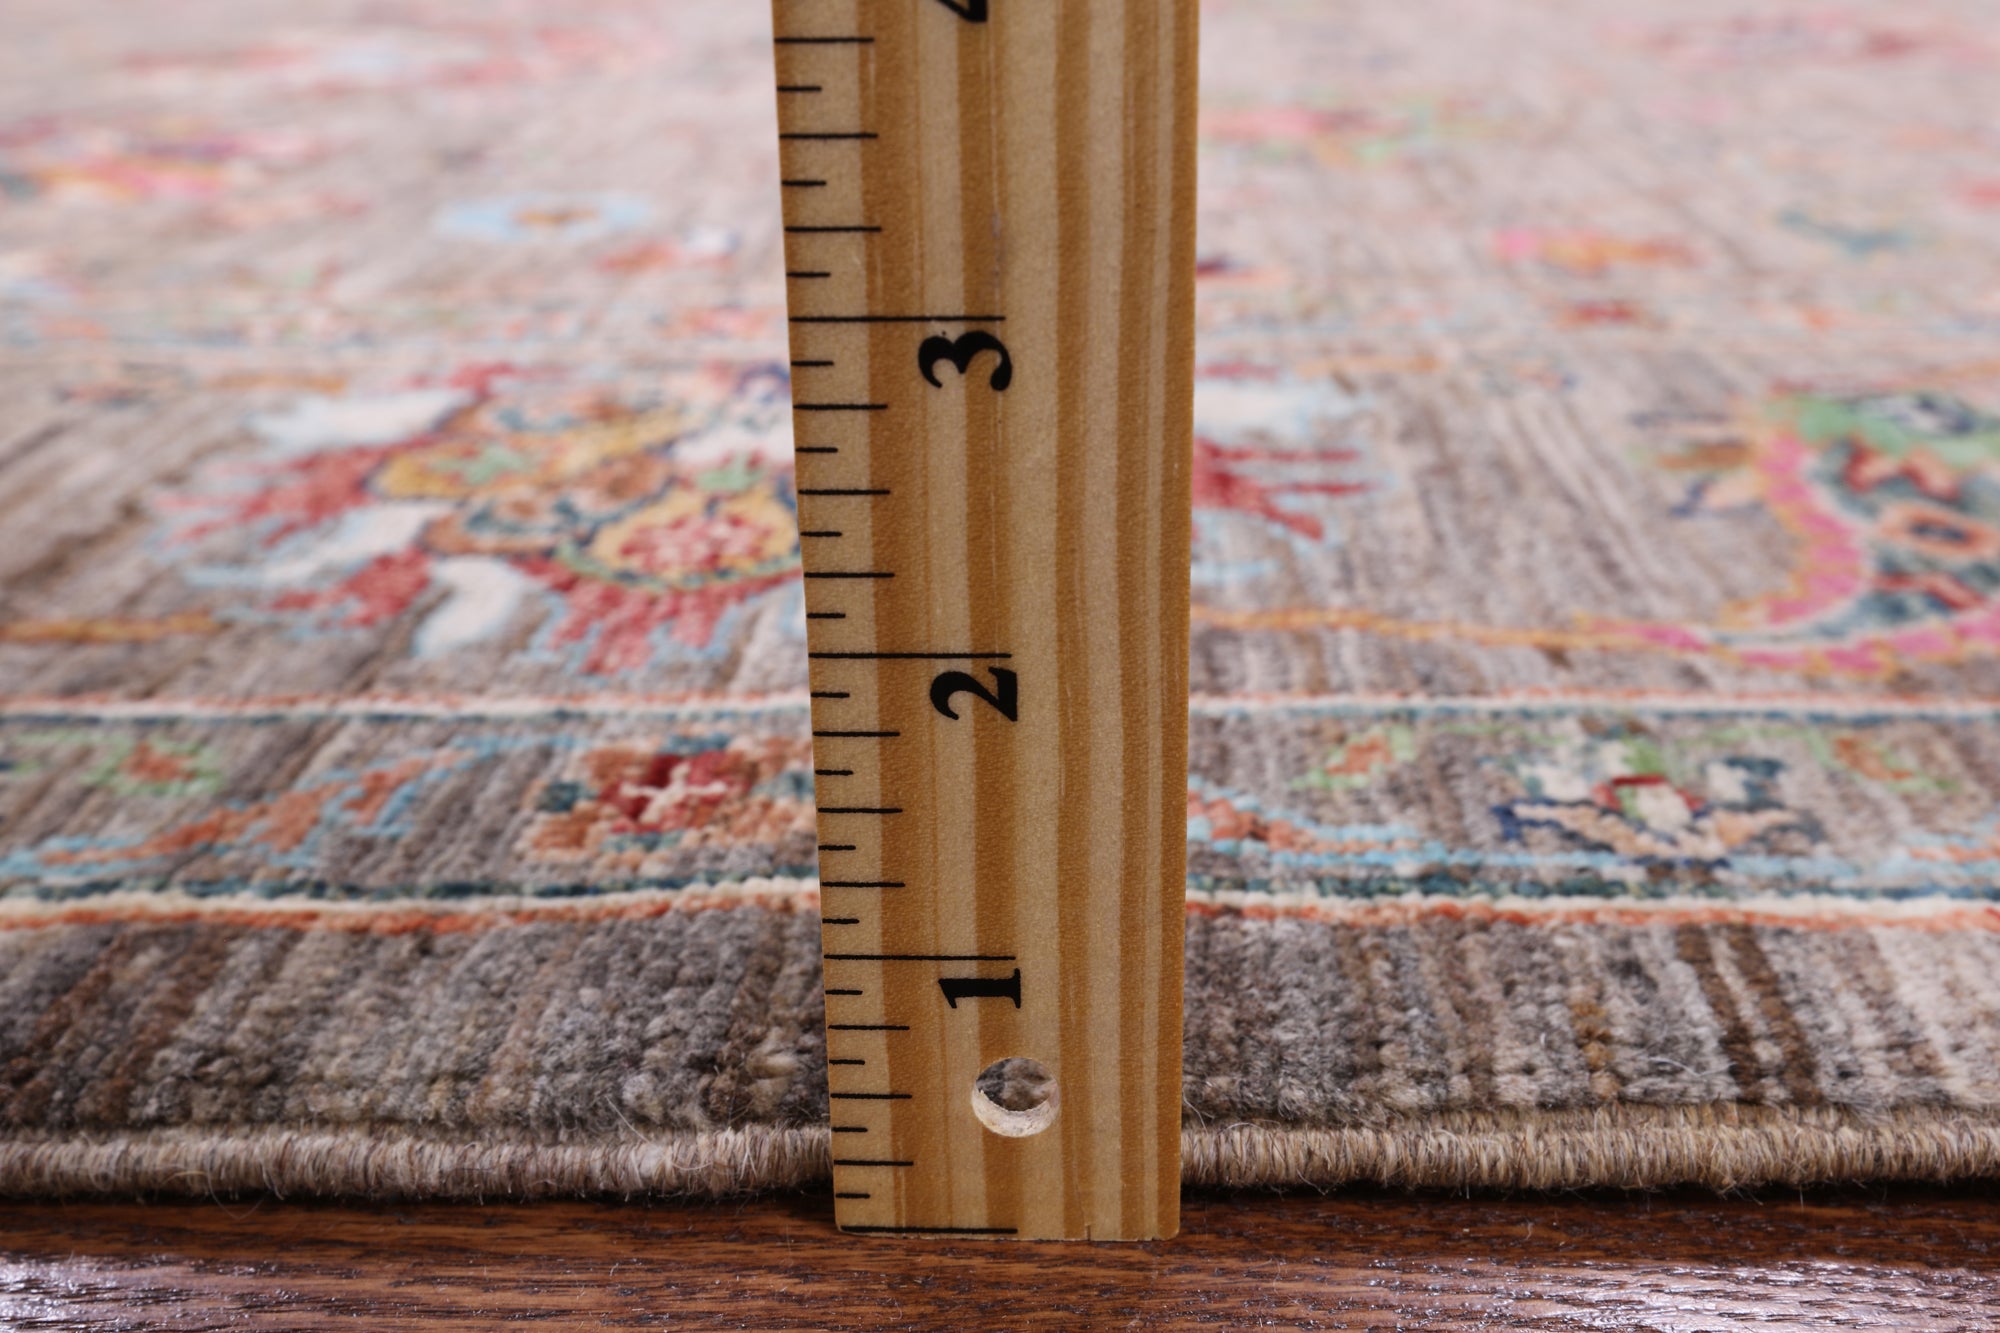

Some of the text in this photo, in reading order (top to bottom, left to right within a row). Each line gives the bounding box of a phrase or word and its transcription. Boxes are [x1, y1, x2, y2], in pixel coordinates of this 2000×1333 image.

[918, 330, 1013, 393] 3
[929, 666, 1019, 723] 2
[937, 967, 1023, 1010] 1
